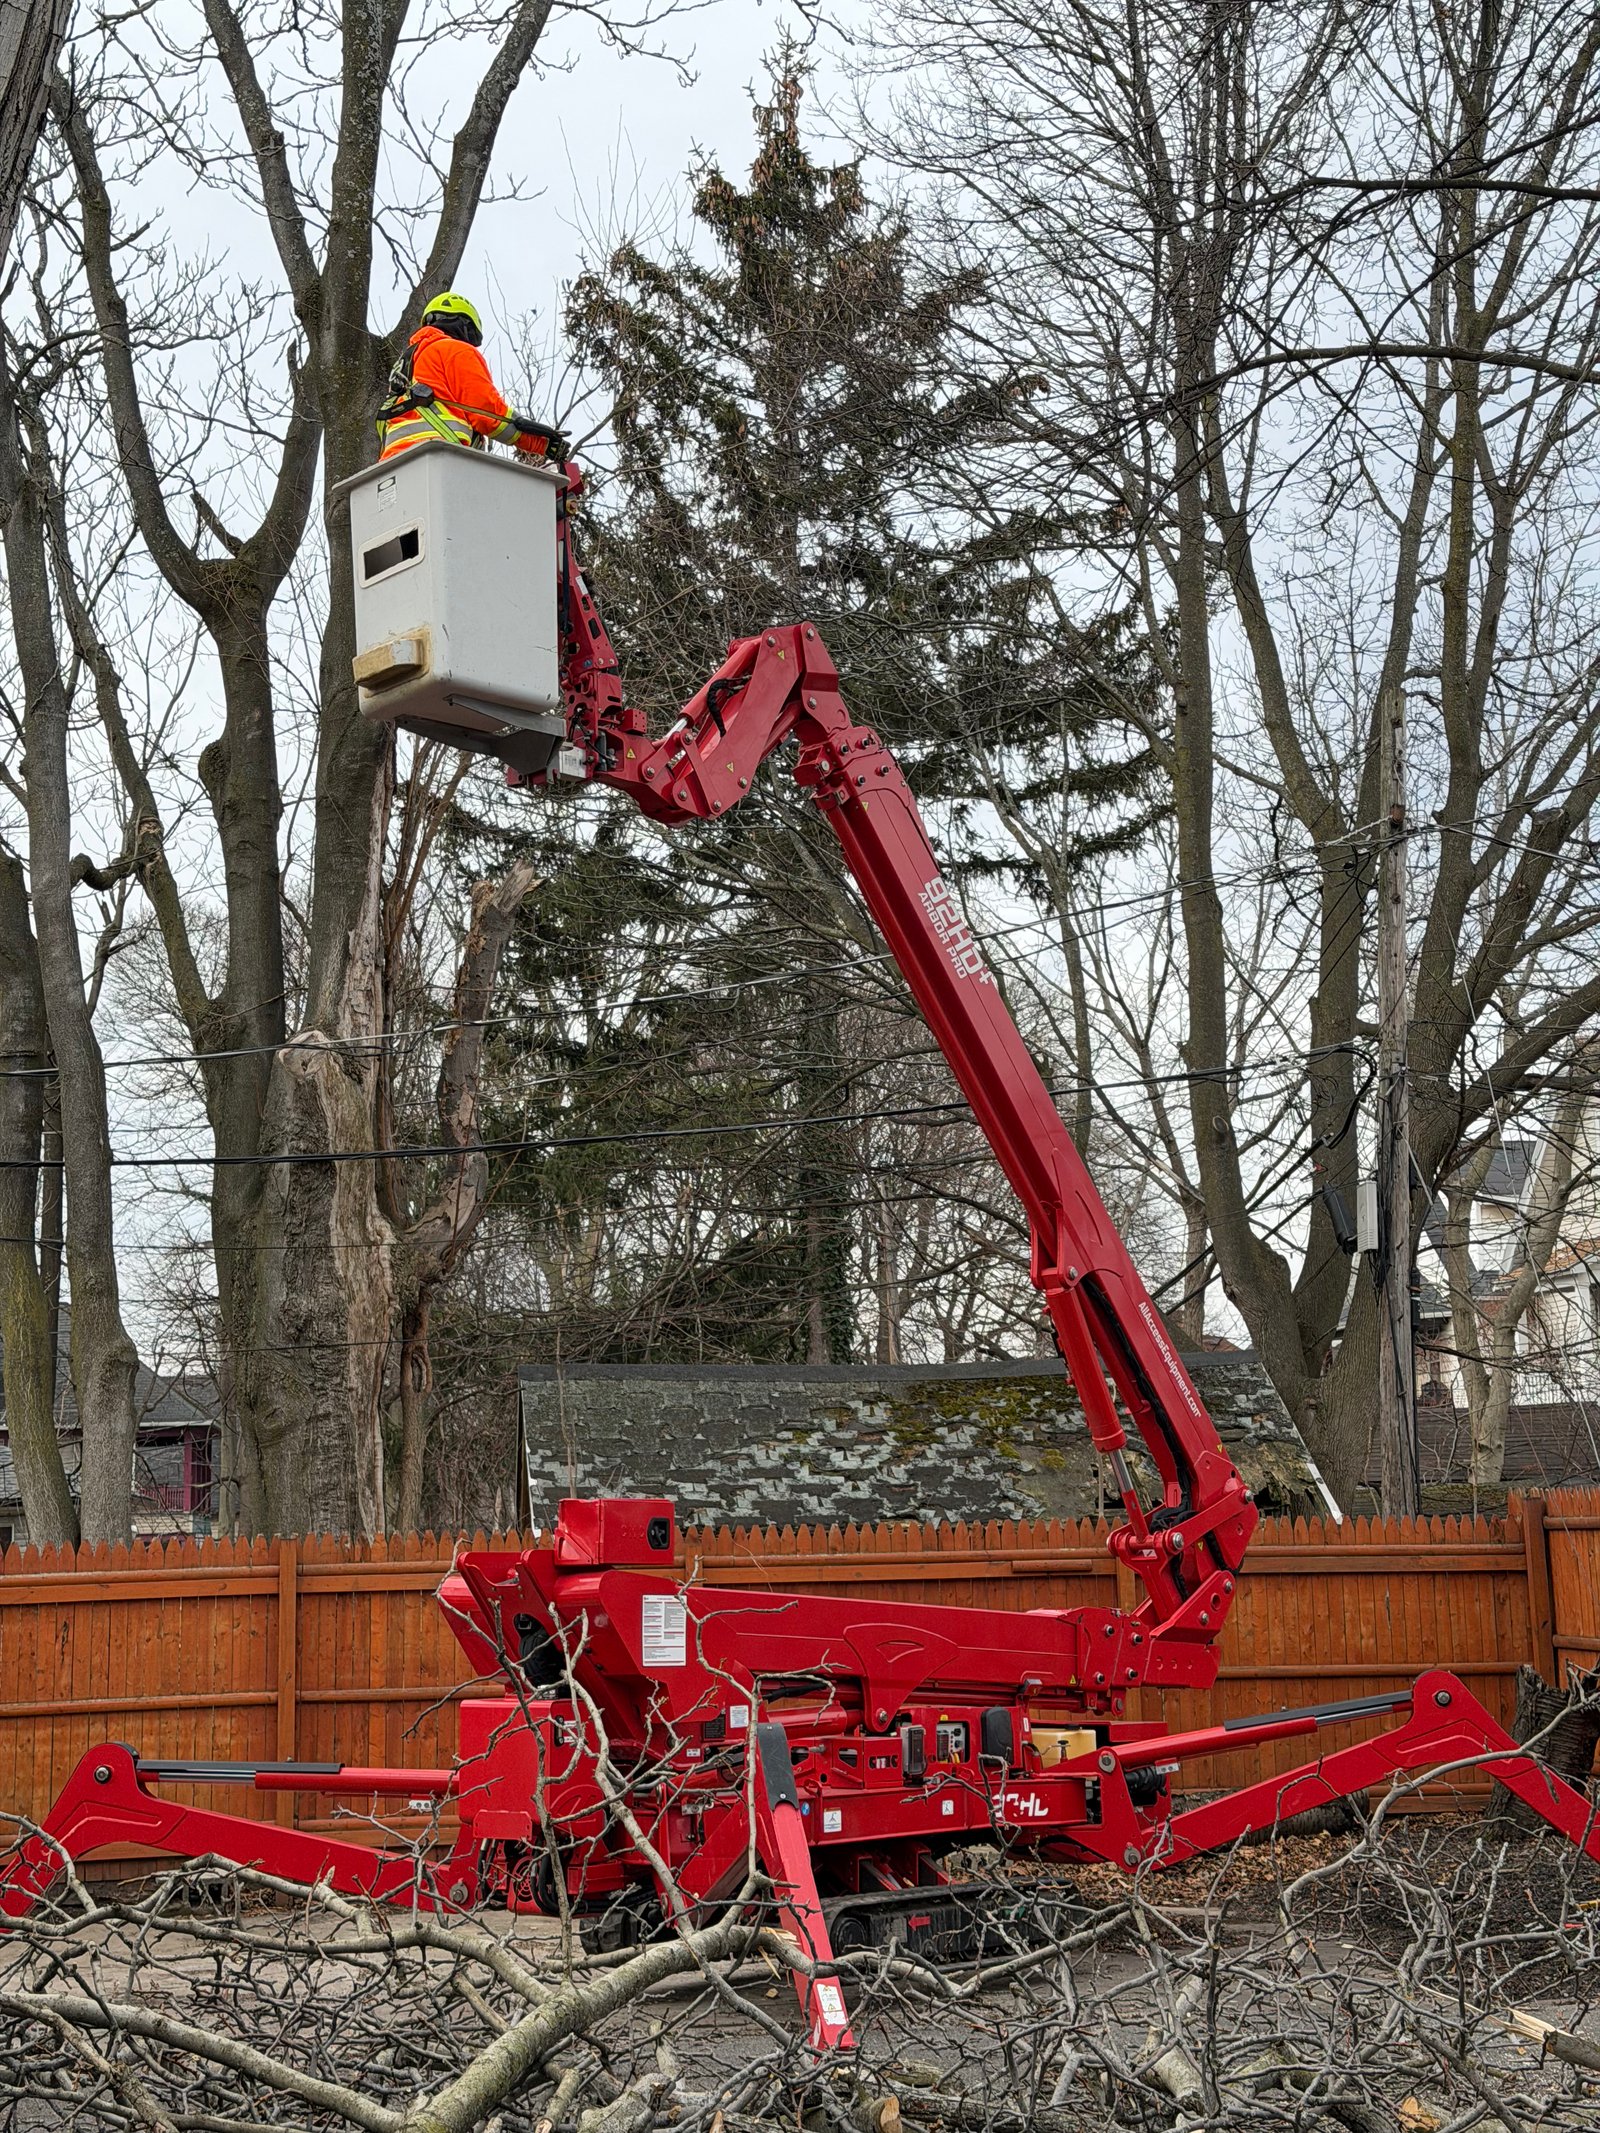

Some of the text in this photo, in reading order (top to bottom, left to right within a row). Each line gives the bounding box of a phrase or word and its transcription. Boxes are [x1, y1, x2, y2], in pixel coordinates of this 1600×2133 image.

[918, 892, 968, 979] ARBOR PRO
[925, 876, 992, 984] 92HD+
[1139, 1301, 1201, 1417] AllAccessEquipment.com
